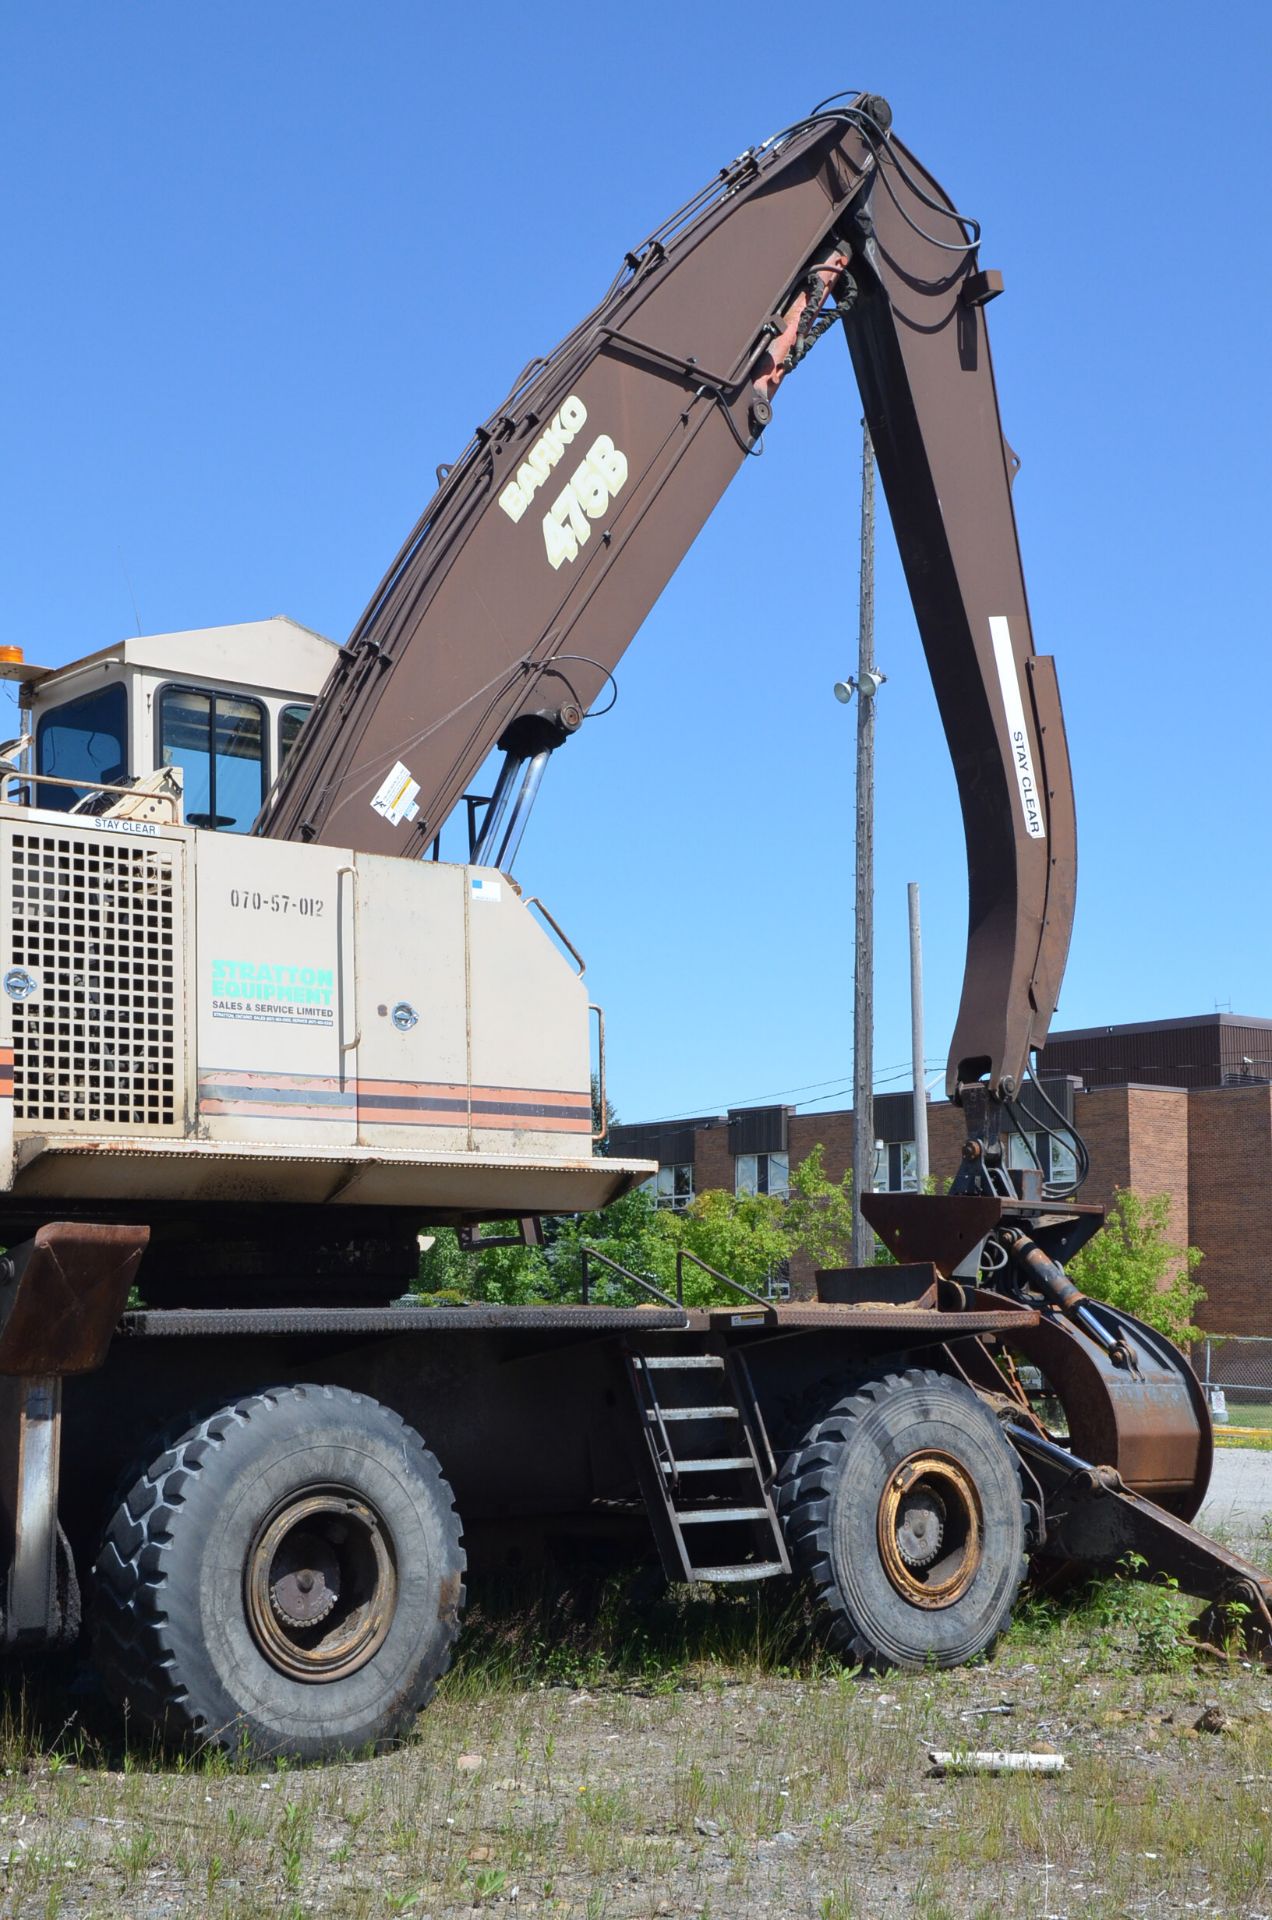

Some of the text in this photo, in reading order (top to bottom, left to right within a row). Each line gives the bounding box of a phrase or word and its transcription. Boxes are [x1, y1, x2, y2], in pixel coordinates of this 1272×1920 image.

[499, 395, 588, 523] BARKO
[542, 434, 628, 570] 475B
[1013, 731, 1040, 833] STAY CLEAR
[95, 818, 156, 835] STAY CLEAR
[231, 889, 324, 917] 070-57-012
[211, 960, 334, 987] STRATTON
[211, 980, 333, 1006] EQUIPMENT
[212, 1000, 334, 1018] SALES & SERVICE LIMITED
